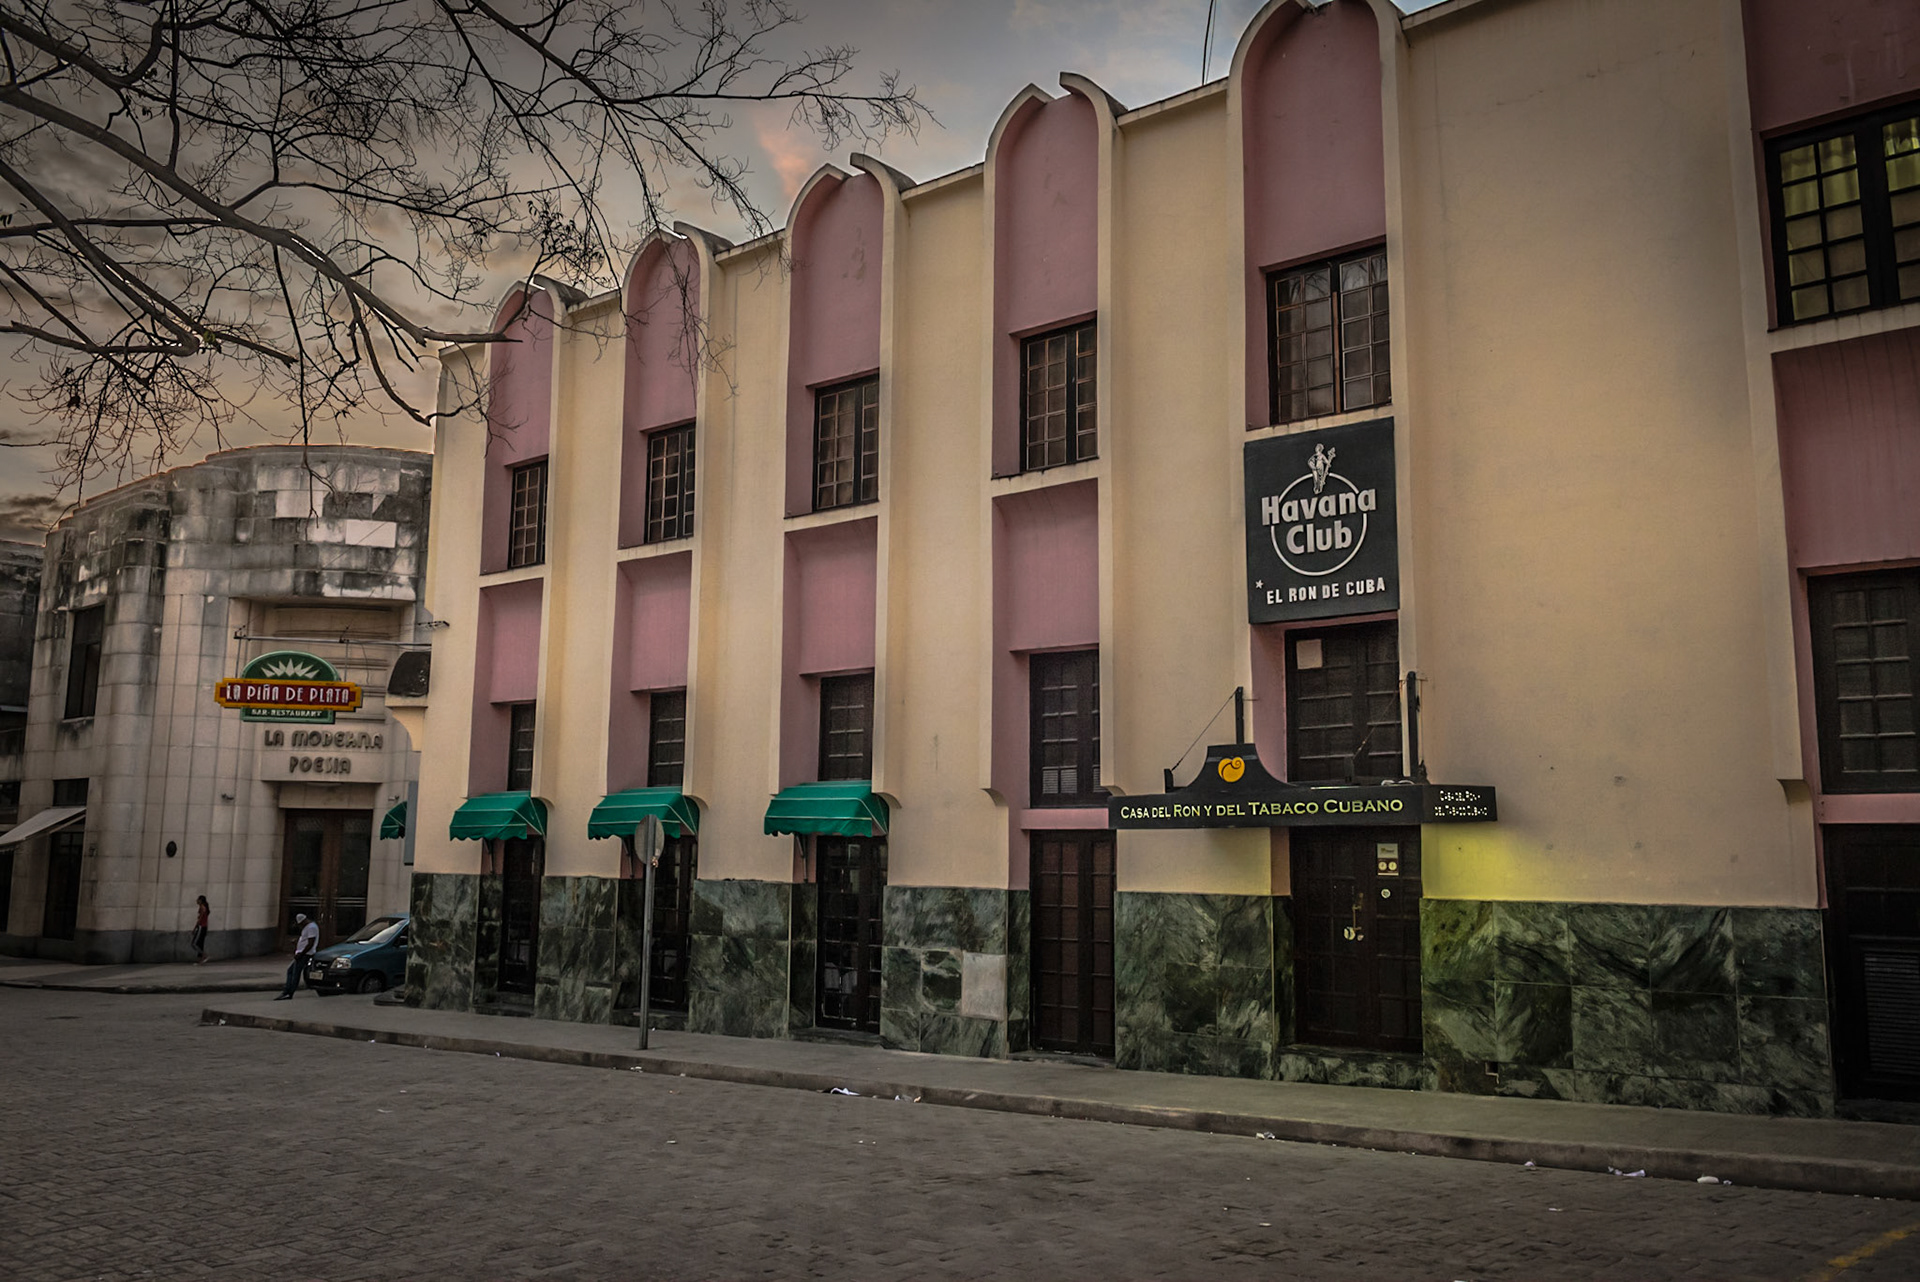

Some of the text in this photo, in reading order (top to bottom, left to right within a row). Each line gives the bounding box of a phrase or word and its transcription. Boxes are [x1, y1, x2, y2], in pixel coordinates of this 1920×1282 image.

[1261, 488, 1377, 526] Havana
[1286, 520, 1352, 555] Club
[1266, 577, 1386, 605] EL RON DE CUBA
[226, 683, 349, 703] LA PIÑA DE PLATA
[264, 730, 383, 749] LA MODERNA
[289, 756, 351, 774] POESIA
[1120, 799, 1403, 819] CASA DEL RON Y DEL TABACO CUBANO
